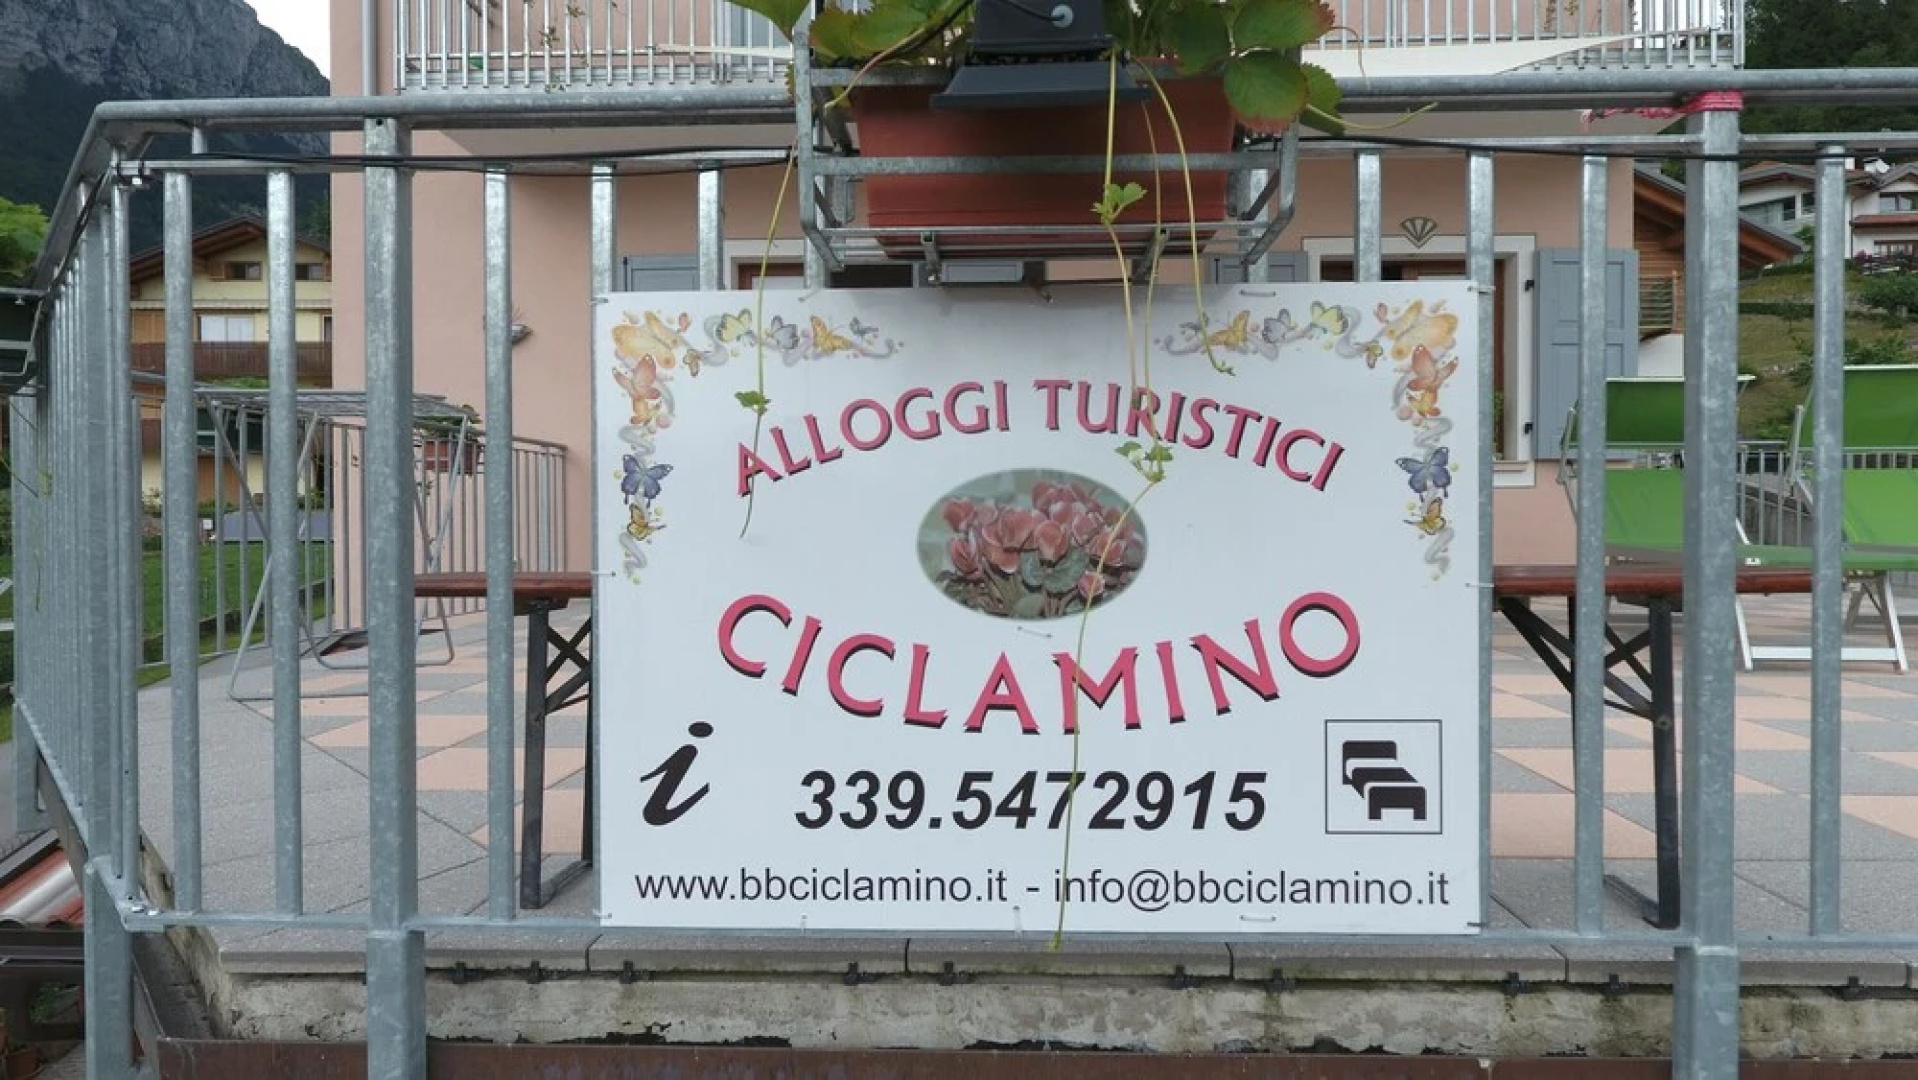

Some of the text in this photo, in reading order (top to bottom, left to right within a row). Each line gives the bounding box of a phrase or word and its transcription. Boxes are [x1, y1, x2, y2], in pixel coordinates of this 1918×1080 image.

[736, 379, 1346, 496] ALLOGGI TURISTICI
[716, 591, 1361, 736] CICLAMINO
[796, 769, 1267, 831] 339.5472915
[634, 867, 1009, 904] www.bbciclamino.it
[1054, 868, 1450, 910] info@bbciclamino.it
